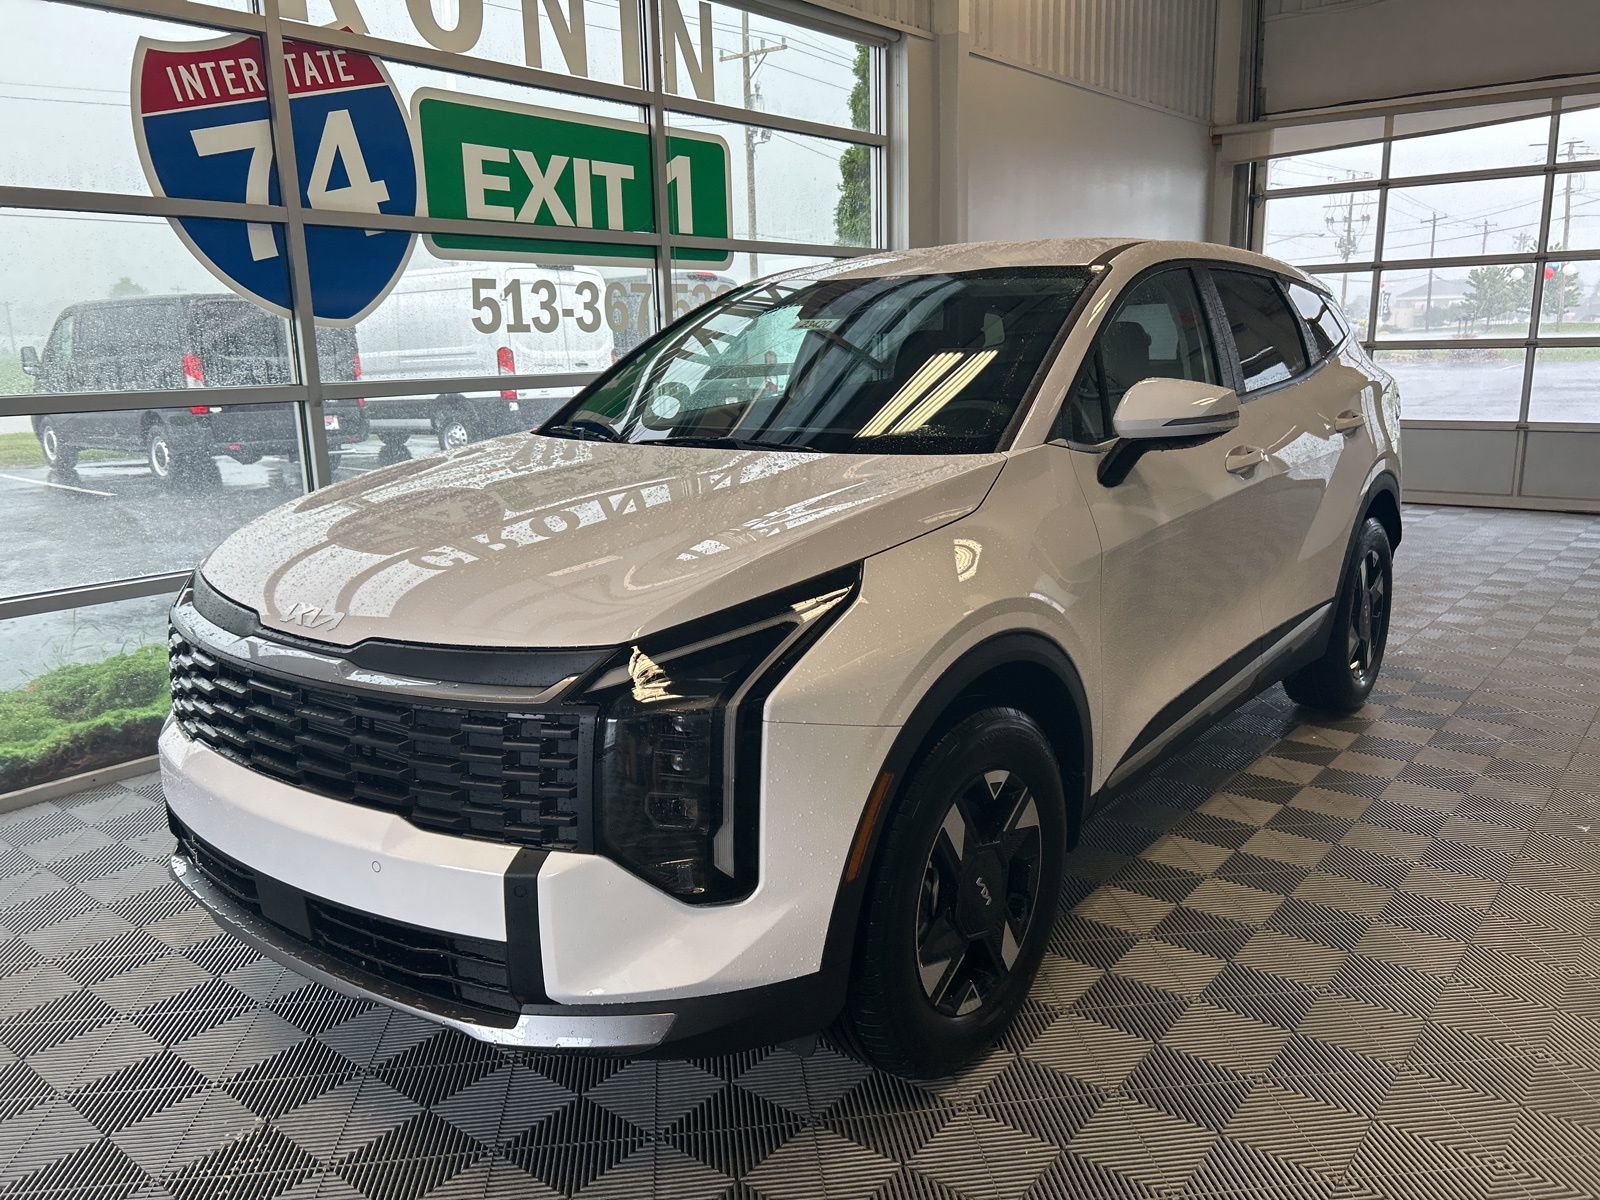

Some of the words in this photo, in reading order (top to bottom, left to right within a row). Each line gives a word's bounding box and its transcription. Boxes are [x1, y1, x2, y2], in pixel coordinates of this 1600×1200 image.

[165, 50, 355, 102] INTERTATE
[278, 0, 715, 102] NIN
[189, 108, 391, 262] 74
[461, 142, 635, 231] EXIT
[665, 155, 694, 235] 1
